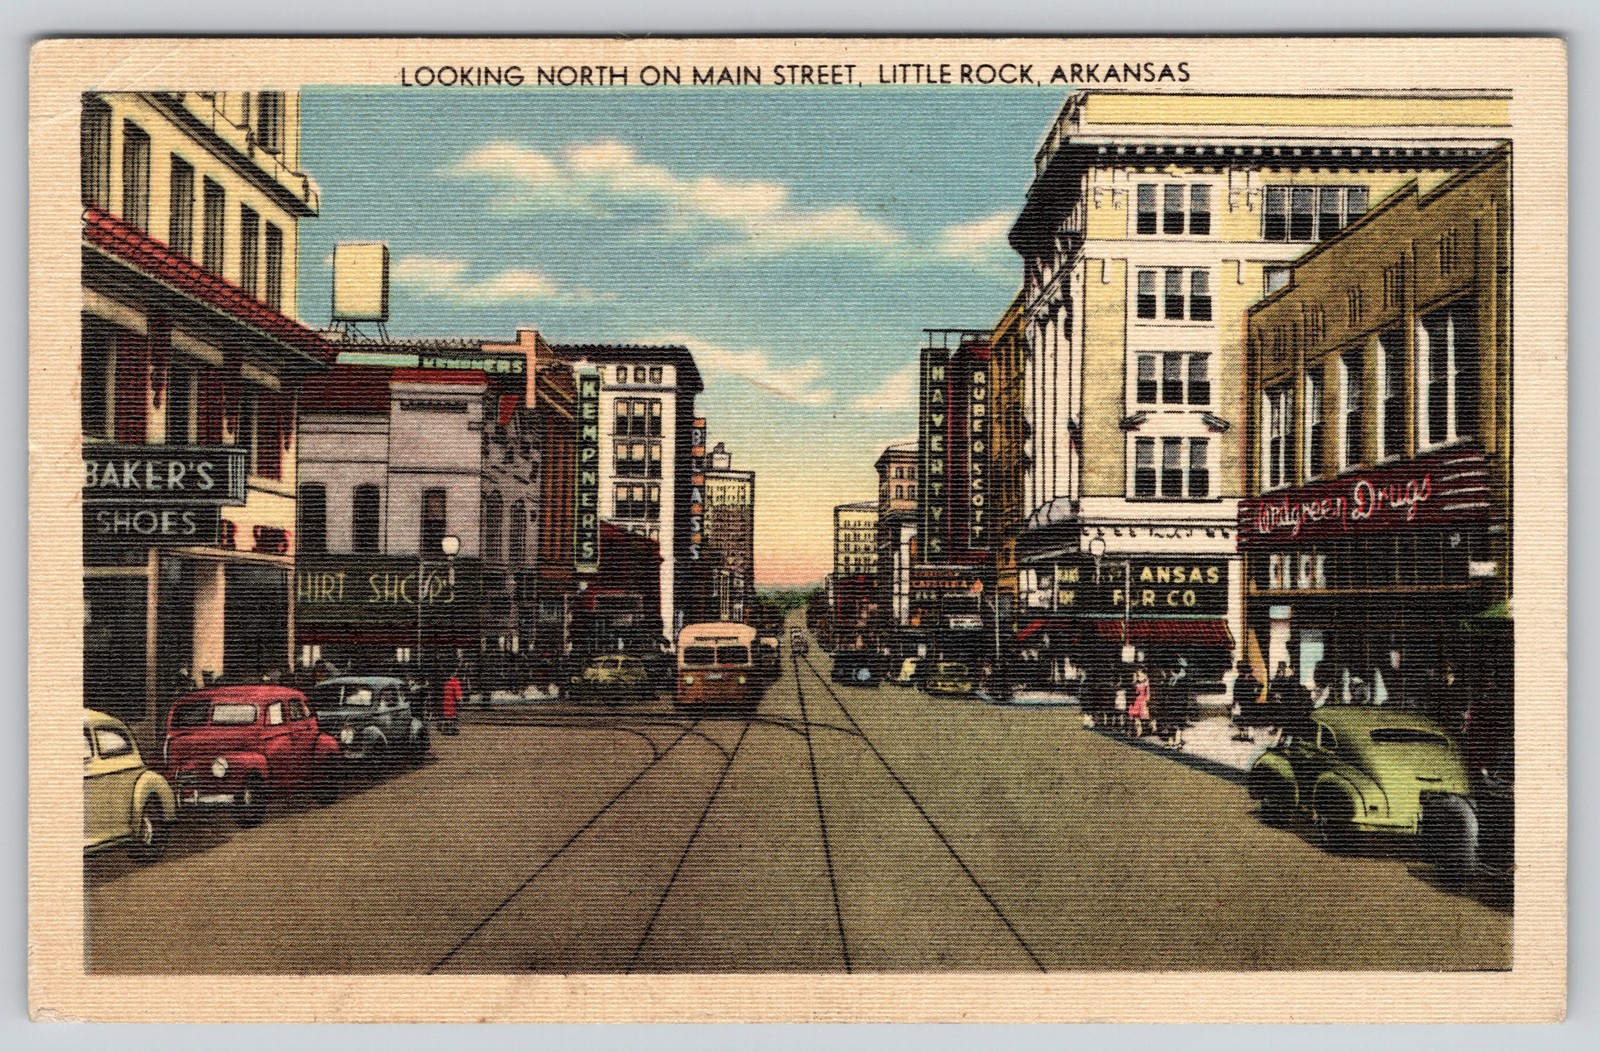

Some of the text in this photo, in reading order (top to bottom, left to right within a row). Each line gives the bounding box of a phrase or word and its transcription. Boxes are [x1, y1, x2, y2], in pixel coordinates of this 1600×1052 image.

[401, 62, 1191, 88] LOOKING NORTH ON MAIN STREET, LITTLE ROCK, ARKANSAS
[973, 370, 986, 433] RUBE
[84, 460, 215, 491] BAKER'S
[581, 380, 598, 558] KEMPNER'S
[972, 462, 985, 538] SCOTT
[1351, 474, 1432, 521] Drugs
[97, 510, 197, 535] SHOES
[1092, 566, 1220, 584] ANSAS
[1166, 589, 1196, 607] CO
